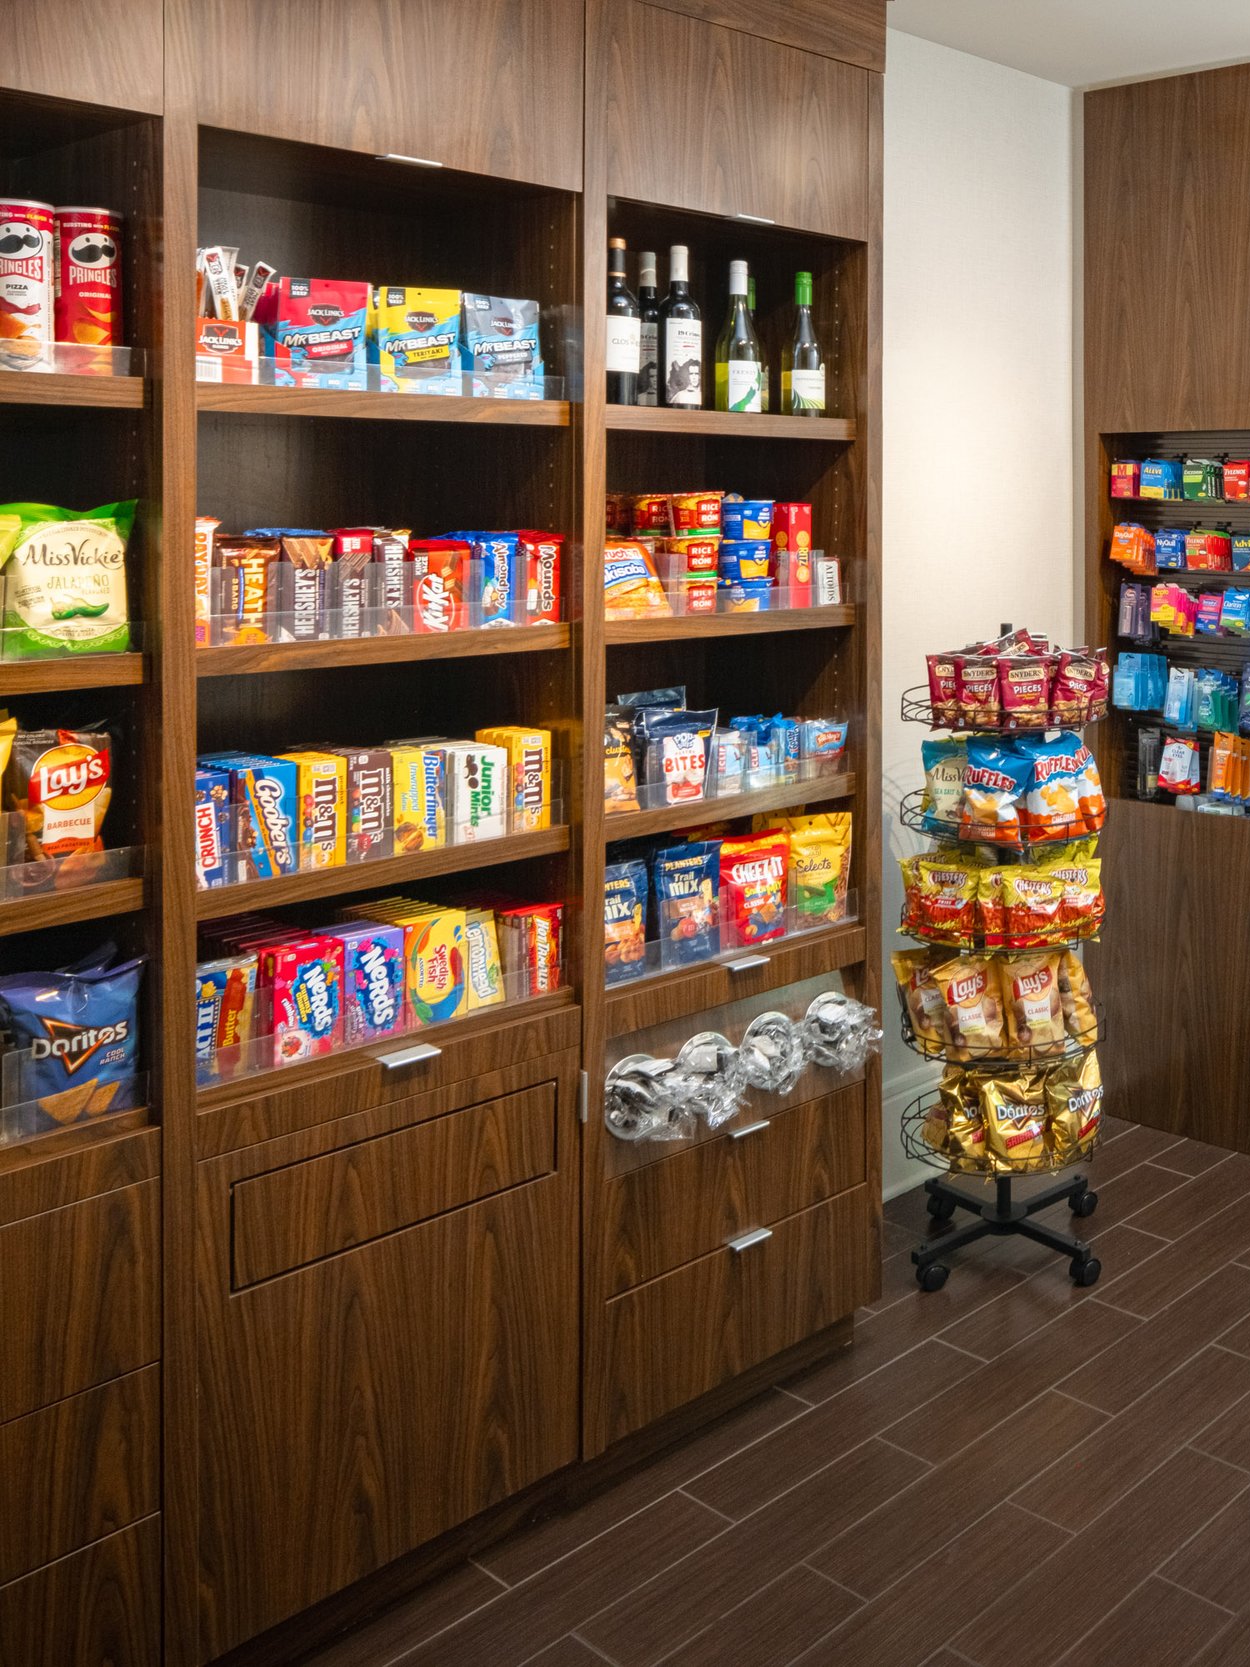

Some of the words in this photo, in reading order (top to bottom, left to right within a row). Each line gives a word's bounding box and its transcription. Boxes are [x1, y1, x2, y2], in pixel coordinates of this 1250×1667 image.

[0, 258, 42, 281] RINGLES
[68, 265, 117, 288] PRINGLES
[5, 283, 29, 291] PIZZA
[701, 503, 718, 511] RICE
[22, 543, 70, 567] Miss
[64, 539, 125, 570] Vickie'
[691, 546, 712, 555] RICE
[384, 545, 404, 608] HERSHEY'S
[492, 541, 510, 589] Almond
[538, 545, 557, 612] Mounds
[241, 558, 265, 628] HEATH
[825, 564, 836, 602] ALTOIDS
[294, 568, 316, 637] HERSHEY'S
[342, 578, 361, 638] HERSHEY'S
[965, 683, 993, 693] PIECES
[1013, 685, 1042, 693] PIECES
[664, 753, 706, 774] BITES
[39, 755, 105, 801] Lay's
[480, 754, 496, 817] Junior
[964, 765, 1017, 792] RUFFLES
[423, 755, 441, 838] Butterfinger
[470, 790, 480, 828] Mints
[46, 817, 92, 831] BARBECUE
[254, 778, 292, 866] Goobers
[201, 806, 217, 869] CRUNCH
[673, 871, 695, 882] Trail
[795, 857, 833, 874] Selects
[605, 878, 631, 891] NTERS
[668, 879, 699, 897] mix
[605, 894, 622, 906] rail
[426, 956, 440, 984] Fish
[434, 943, 450, 991] Swedish
[952, 973, 985, 1003] Lay's
[1017, 970, 1050, 1000] Lay's
[959, 1012, 982, 1022] CLASSIC
[1026, 1006, 1049, 1015] CLASSIC
[32, 1020, 130, 1060] Doritos
[222, 1009, 238, 1047] Butter
[99, 1053, 127, 1065] RANCH
[106, 1046, 126, 1059] COOL
[996, 1103, 1046, 1120] Doritos
[1067, 1085, 1105, 1114] Doritos
